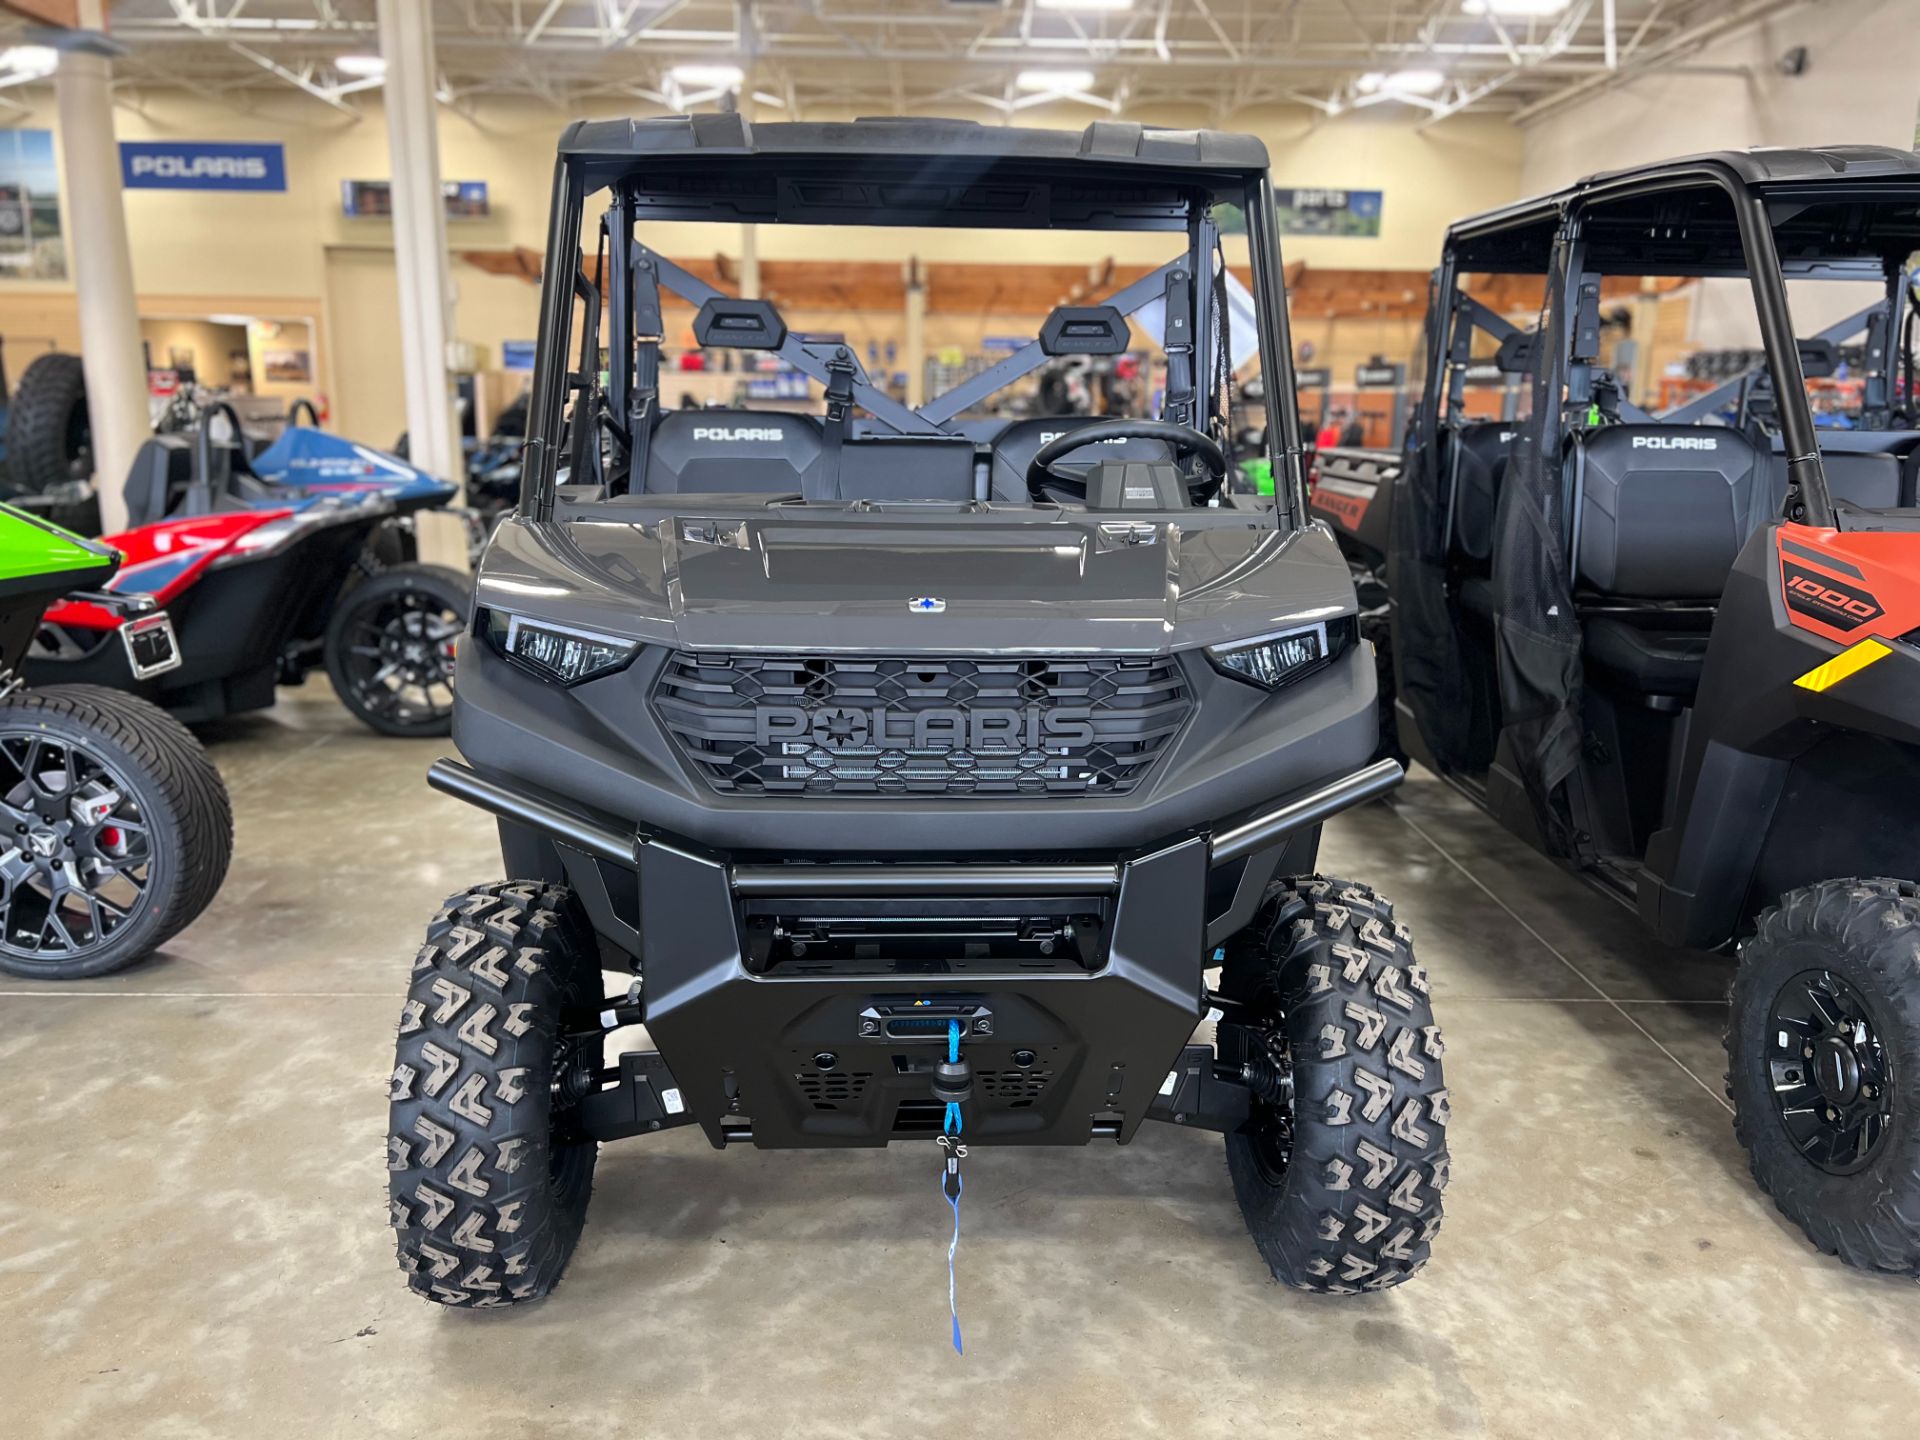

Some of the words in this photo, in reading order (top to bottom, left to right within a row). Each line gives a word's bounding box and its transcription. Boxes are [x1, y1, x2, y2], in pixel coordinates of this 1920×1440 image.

[131, 155, 267, 178] POLARIS
[693, 428, 783, 441] POLARIS
[1632, 436, 1718, 450] POLARIS
[1786, 575, 1878, 618] 1000
[756, 706, 1095, 748] POLARIS
